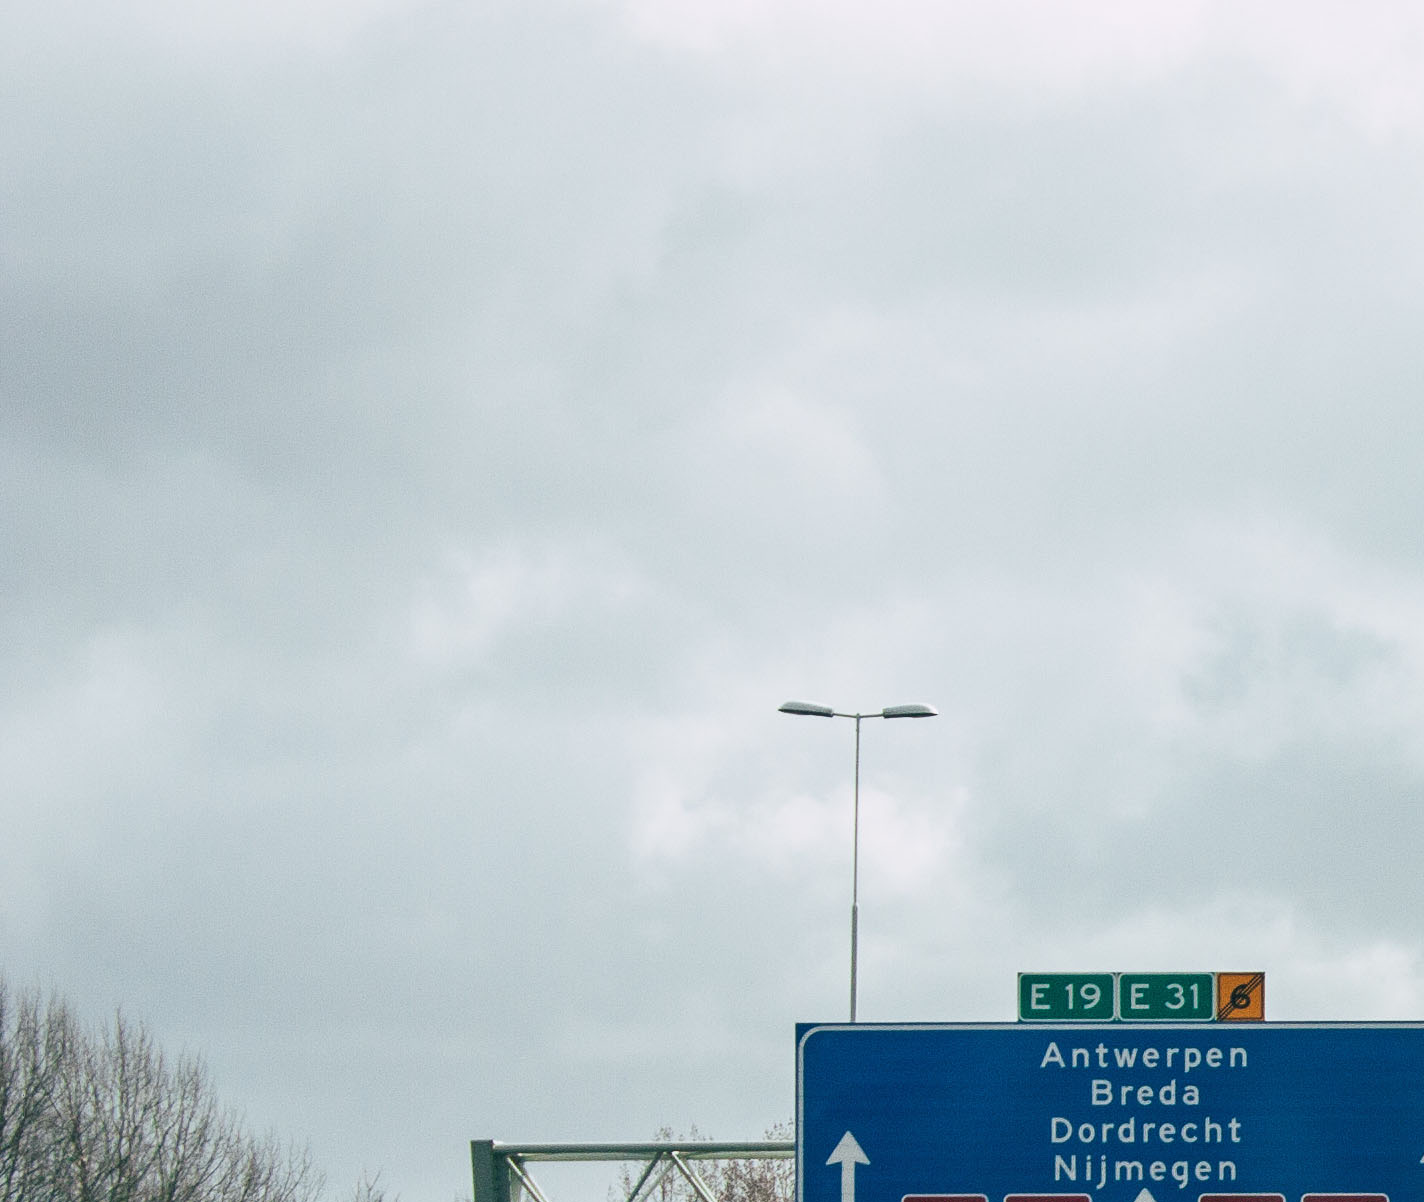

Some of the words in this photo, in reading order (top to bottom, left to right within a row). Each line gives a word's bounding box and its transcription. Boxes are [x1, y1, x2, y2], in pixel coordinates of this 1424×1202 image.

[1030, 983, 1051, 1010] E
[1065, 983, 1101, 1010] 19
[1130, 983, 1150, 1010] E
[1165, 983, 1199, 1010] 31
[1040, 1041, 1248, 1073] Antwerpen
[1091, 1079, 1200, 1106] Breda
[1051, 1117, 1242, 1144] Dordrecht
[1054, 1154, 1237, 1189] Nijmegen
